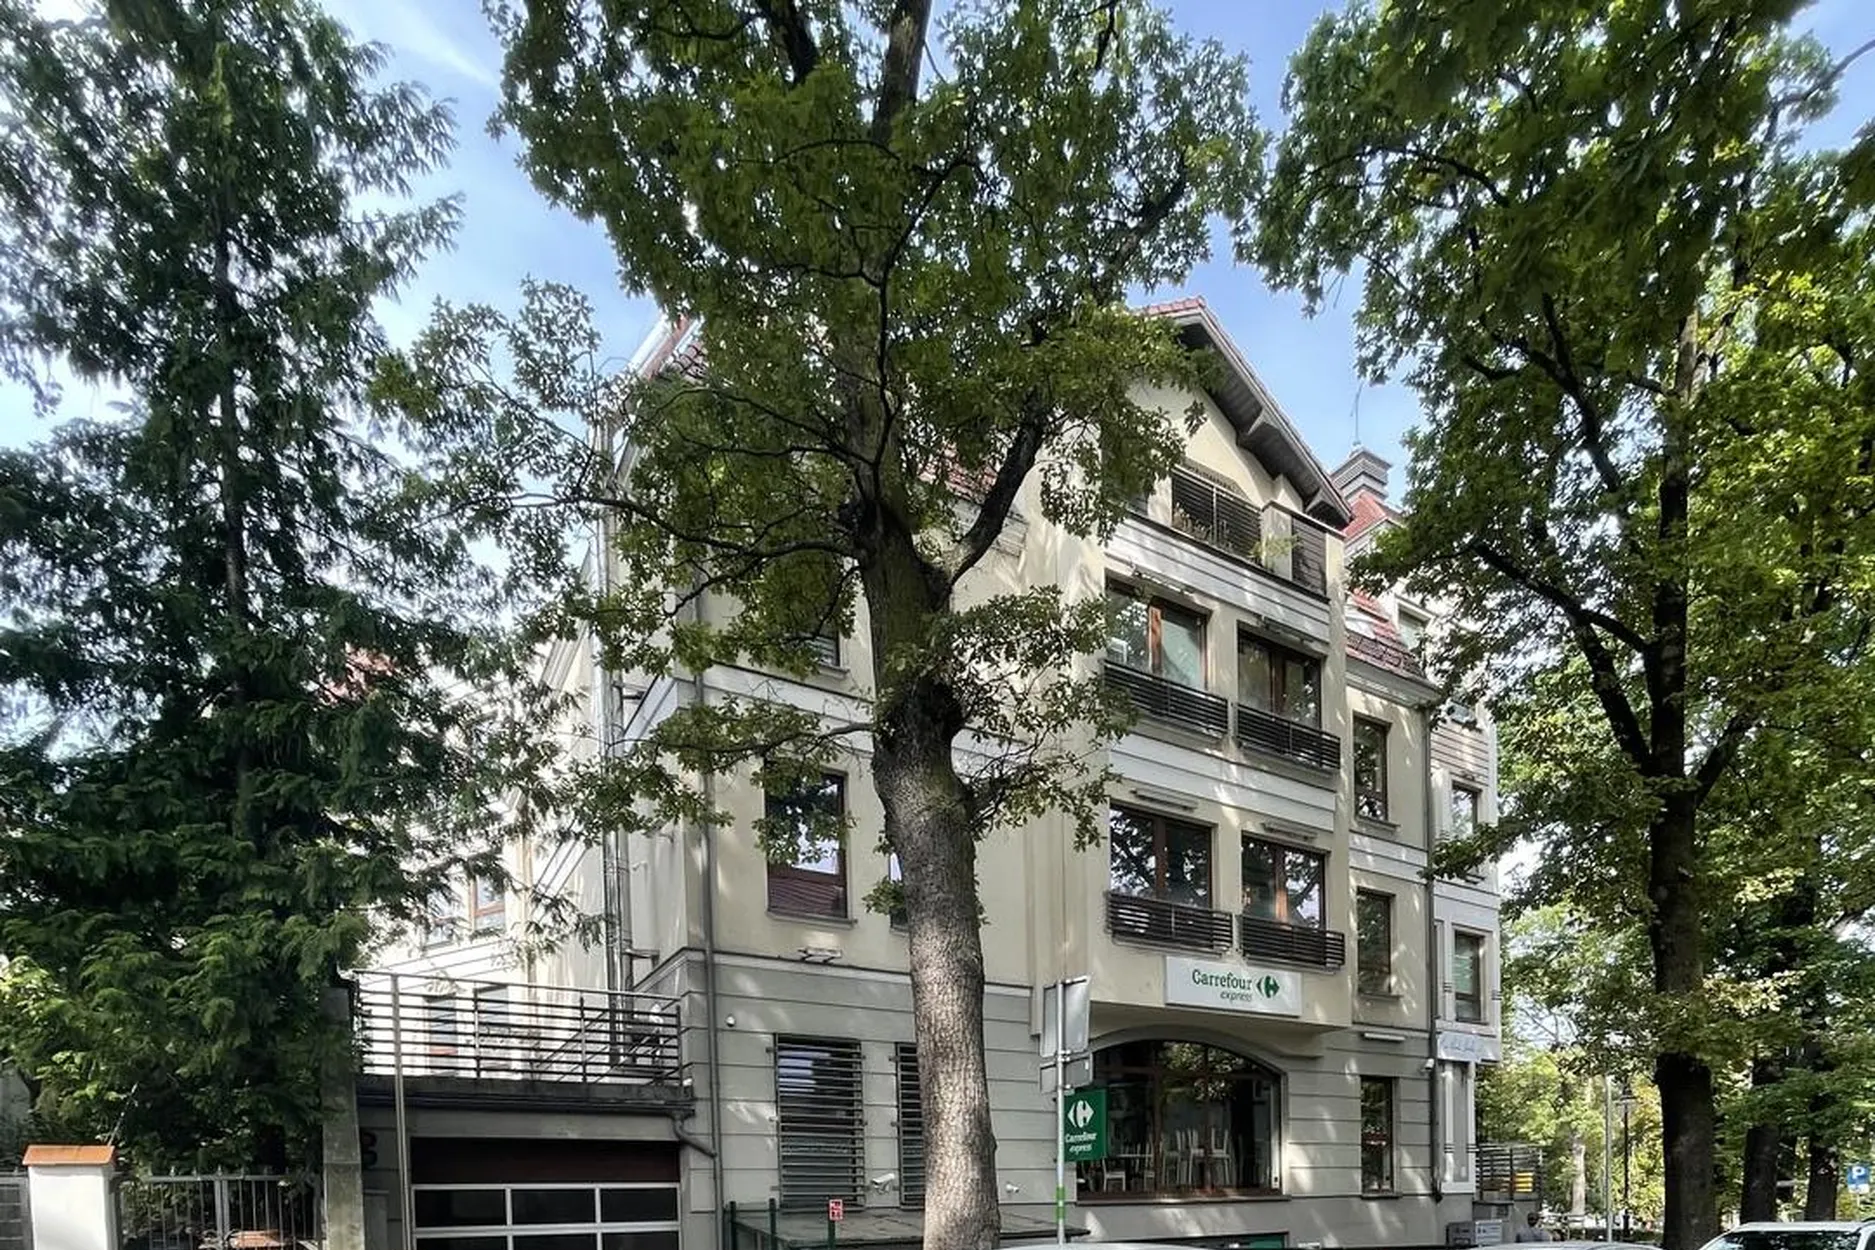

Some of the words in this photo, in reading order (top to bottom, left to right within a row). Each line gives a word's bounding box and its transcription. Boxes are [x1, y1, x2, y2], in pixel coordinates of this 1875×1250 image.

[1192, 969, 1252, 990] Carrefour
[1220, 990, 1252, 1004] express
[1065, 1132, 1097, 1143] Carrefour
[1069, 1143, 1092, 1155] express
[1852, 1166, 1866, 1179] P
